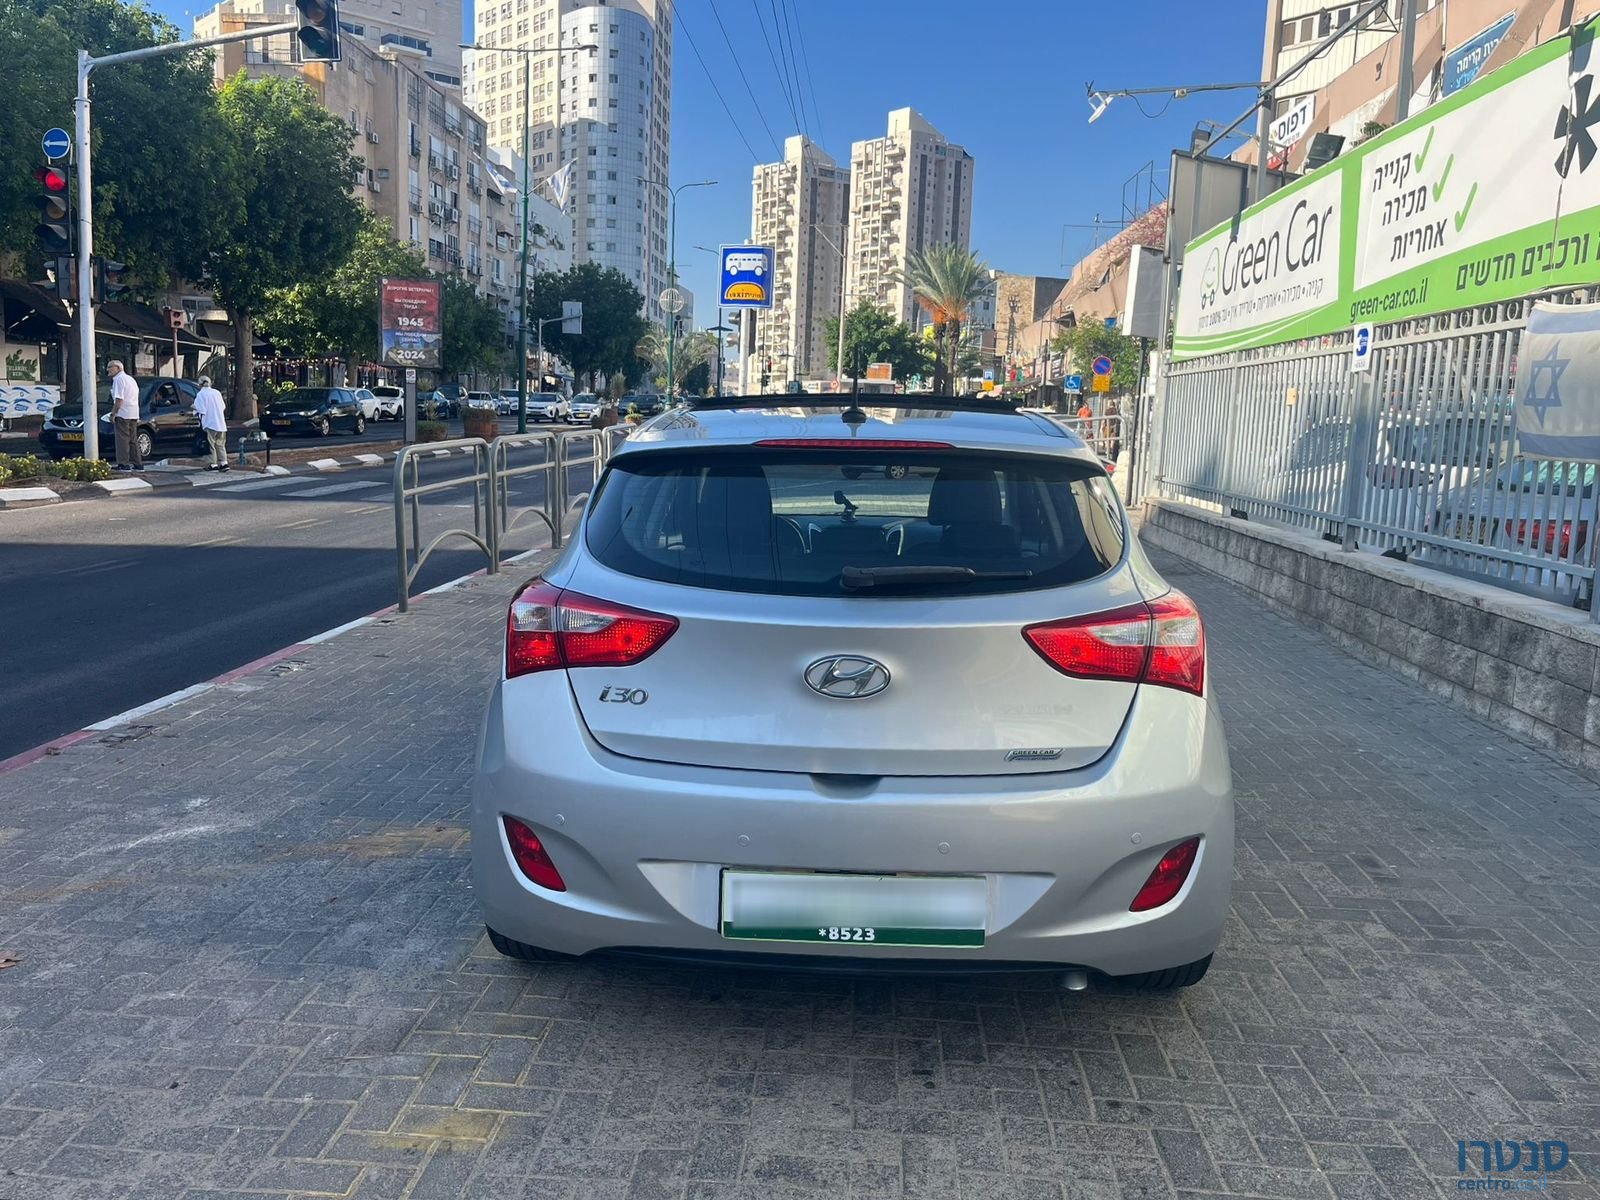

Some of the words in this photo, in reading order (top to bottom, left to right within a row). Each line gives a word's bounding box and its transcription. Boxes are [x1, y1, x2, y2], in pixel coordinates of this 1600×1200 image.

[1278, 104, 1307, 141] דפוס
[1372, 152, 1412, 193] קנייה
[1382, 185, 1427, 226] מכירה
[1222, 230, 1280, 296] Green
[1285, 199, 1333, 272] Car
[1390, 218, 1448, 262] אחריות
[1520, 233, 1590, 277] ורכבים
[1456, 252, 1516, 291] חדשים
[1281, 284, 1302, 303] מכירה
[1350, 277, 1429, 323] green-car.co.il
[397, 316, 424, 327] 1945
[397, 350, 426, 360] 2024
[599, 684, 649, 705] i30
